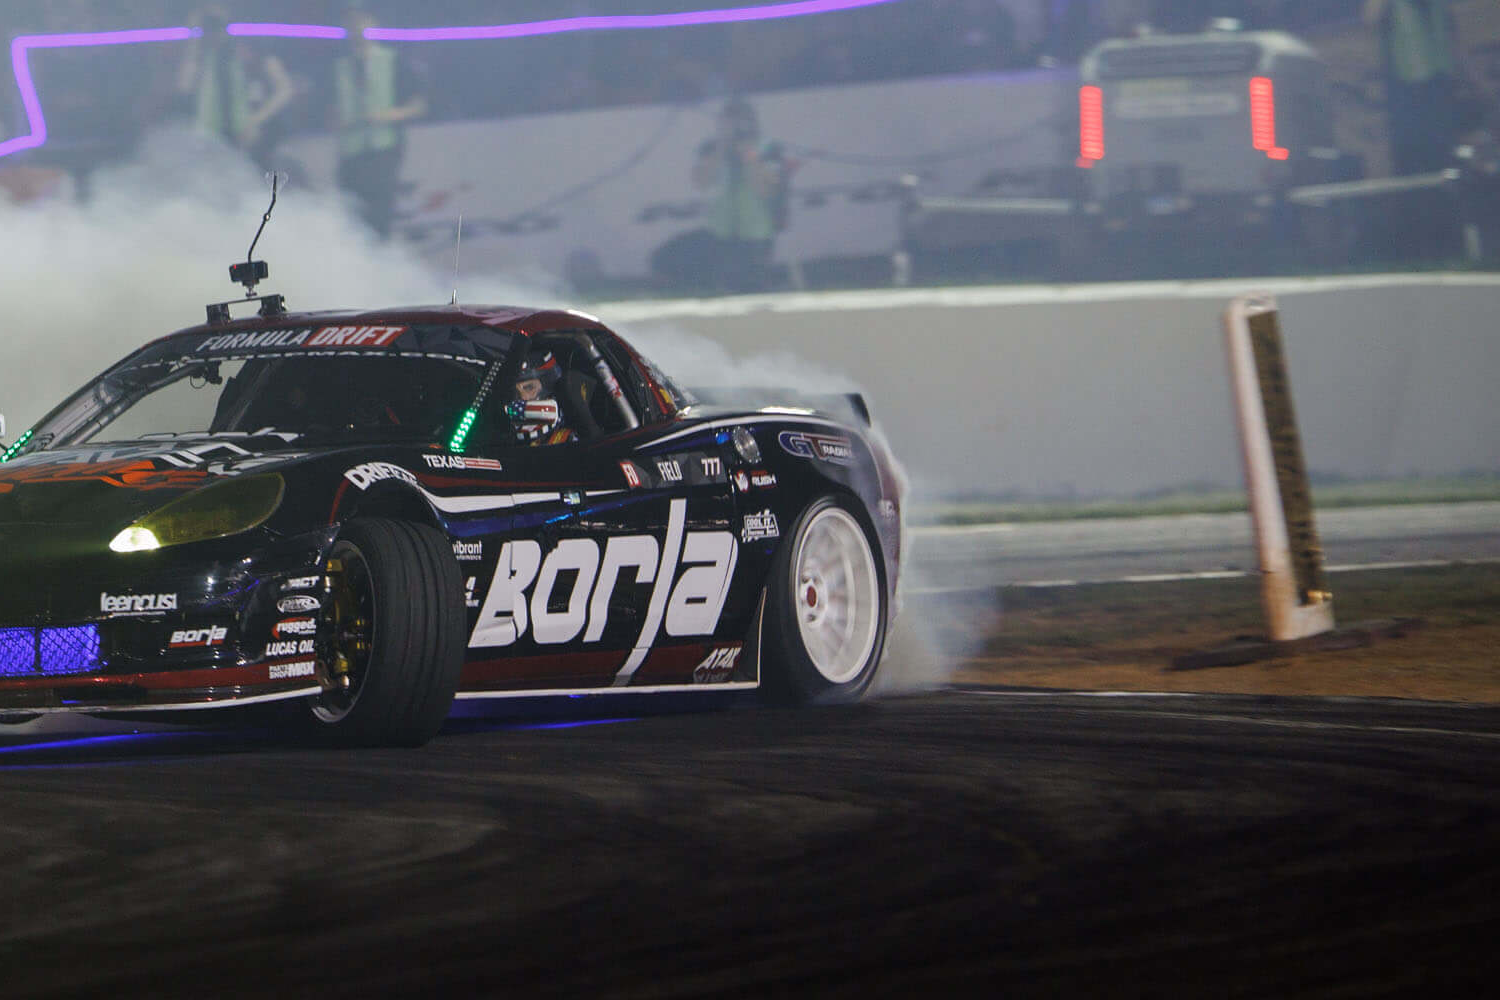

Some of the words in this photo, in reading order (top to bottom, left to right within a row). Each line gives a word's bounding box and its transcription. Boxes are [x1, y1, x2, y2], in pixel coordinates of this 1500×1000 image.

[196, 329, 312, 351] FORMULA
[308, 327, 403, 346] DRIFT
[422, 454, 466, 469] TEXAS
[657, 460, 683, 481] FIELD
[701, 457, 721, 476] 777
[622, 463, 639, 485] FD
[452, 540, 483, 554] vibrant
[265, 640, 298, 657] LUCAS
[298, 639, 315, 654] OIL
